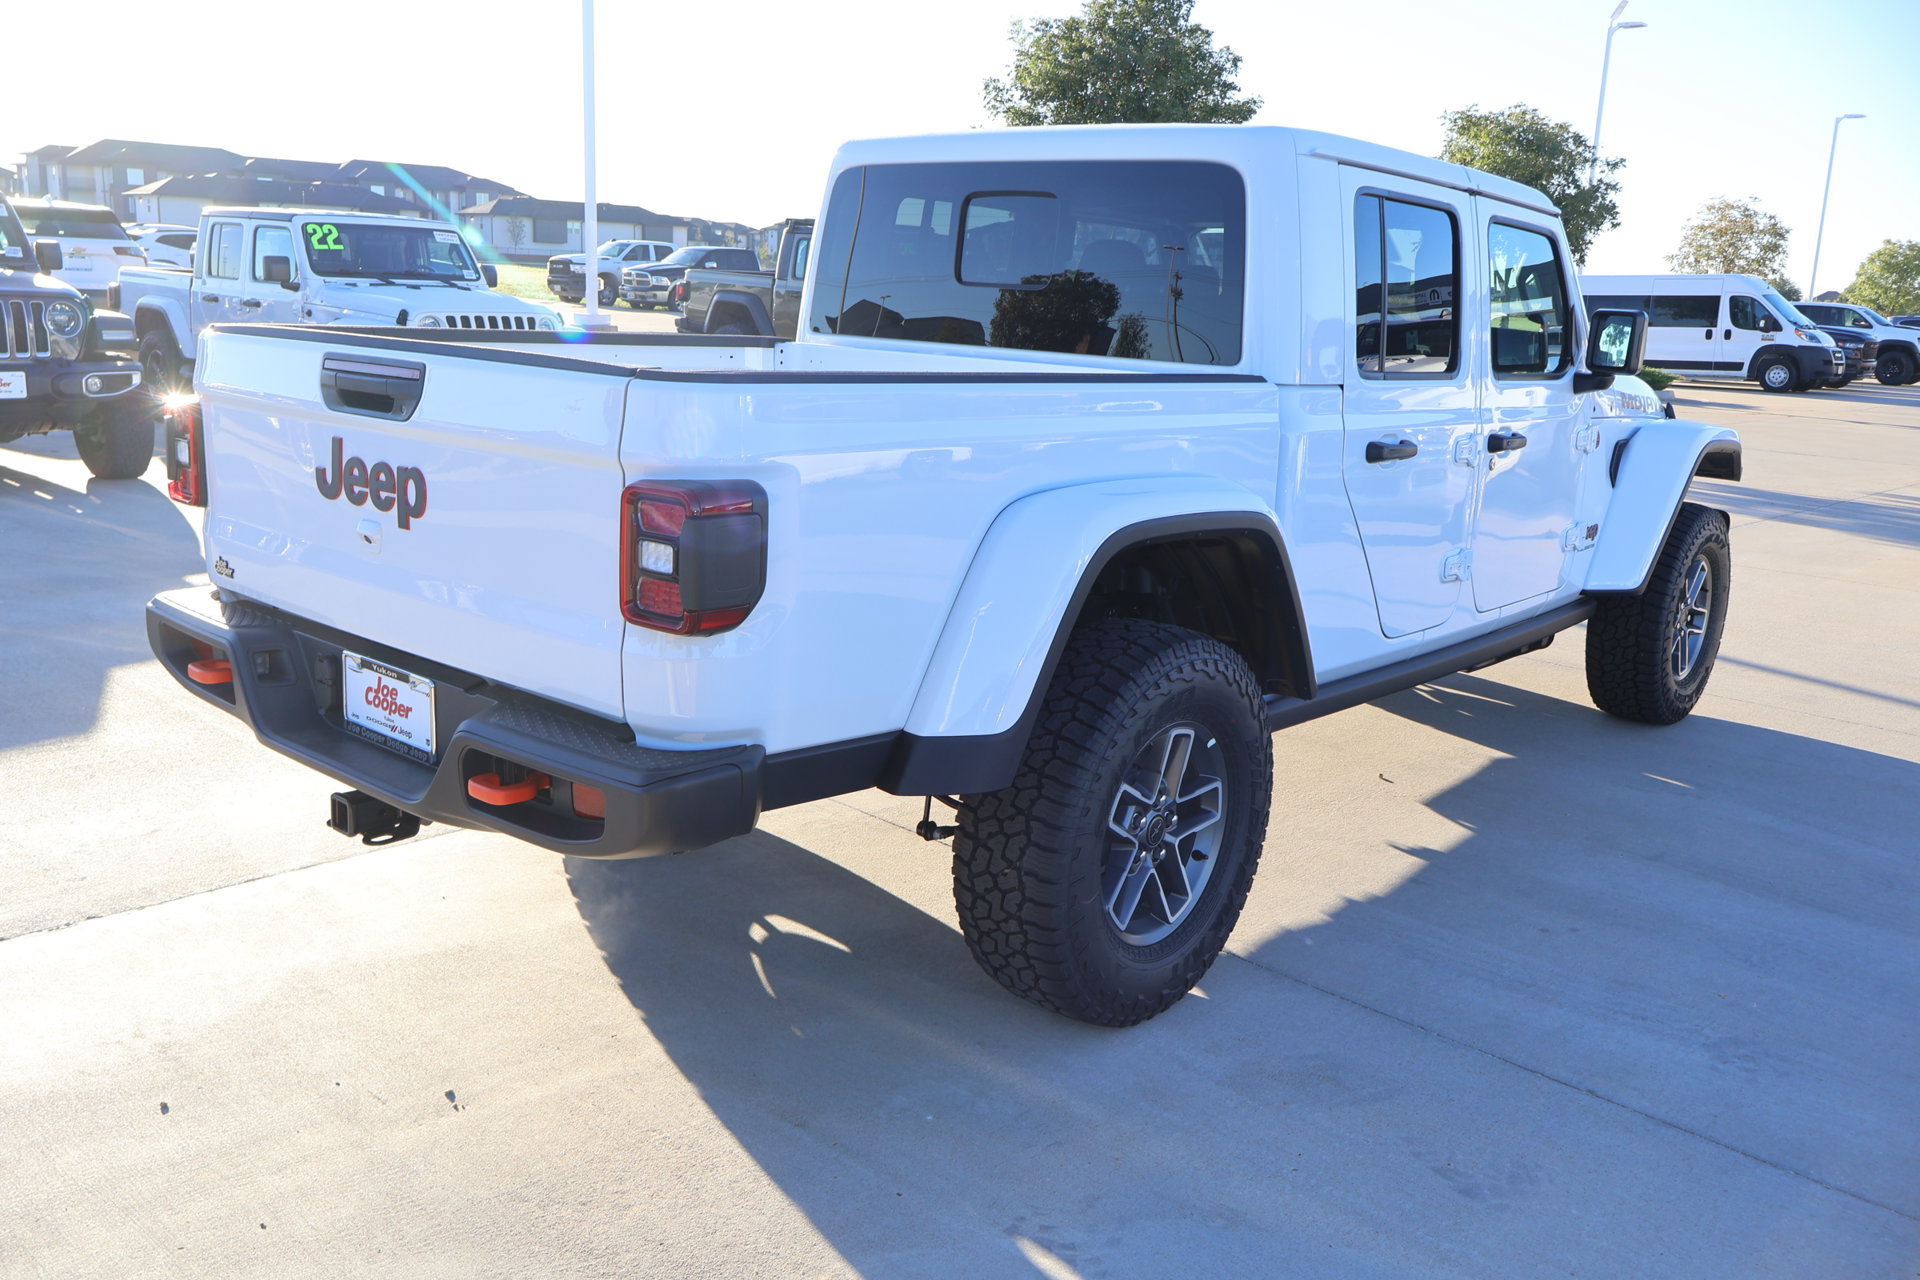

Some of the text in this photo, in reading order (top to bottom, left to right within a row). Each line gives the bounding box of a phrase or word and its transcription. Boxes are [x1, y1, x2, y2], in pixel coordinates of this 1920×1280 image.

[306, 223, 345, 250] 22
[315, 436, 428, 531] Jeep
[372, 663, 398, 679] Yukon
[374, 676, 398, 701] Joe
[365, 686, 413, 719] Cooper
[361, 726, 386, 744] Cooper
[386, 736, 408, 754] Dodge
[410, 745, 428, 762] Jeep
[397, 726, 413, 740] Jeep
